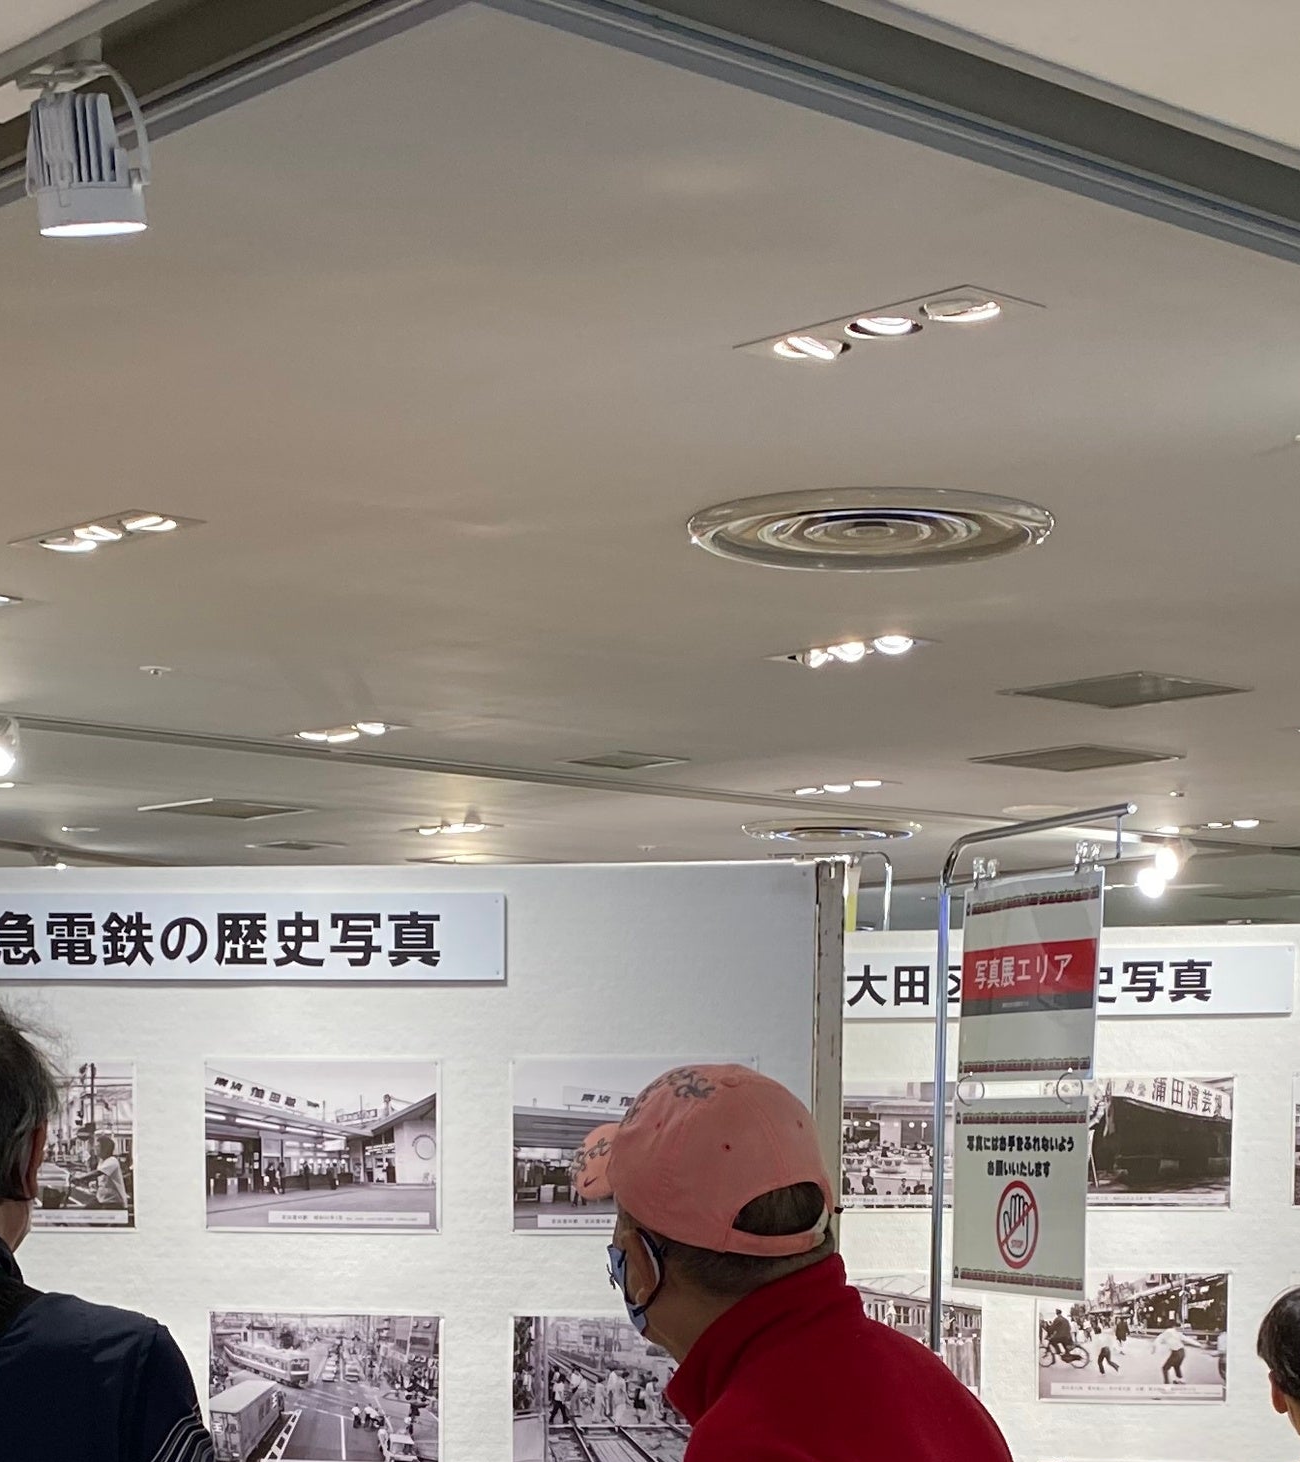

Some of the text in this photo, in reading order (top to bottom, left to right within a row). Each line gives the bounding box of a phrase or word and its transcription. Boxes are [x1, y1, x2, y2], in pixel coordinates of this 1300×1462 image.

[974, 953, 1073, 990] 写真展エリア
